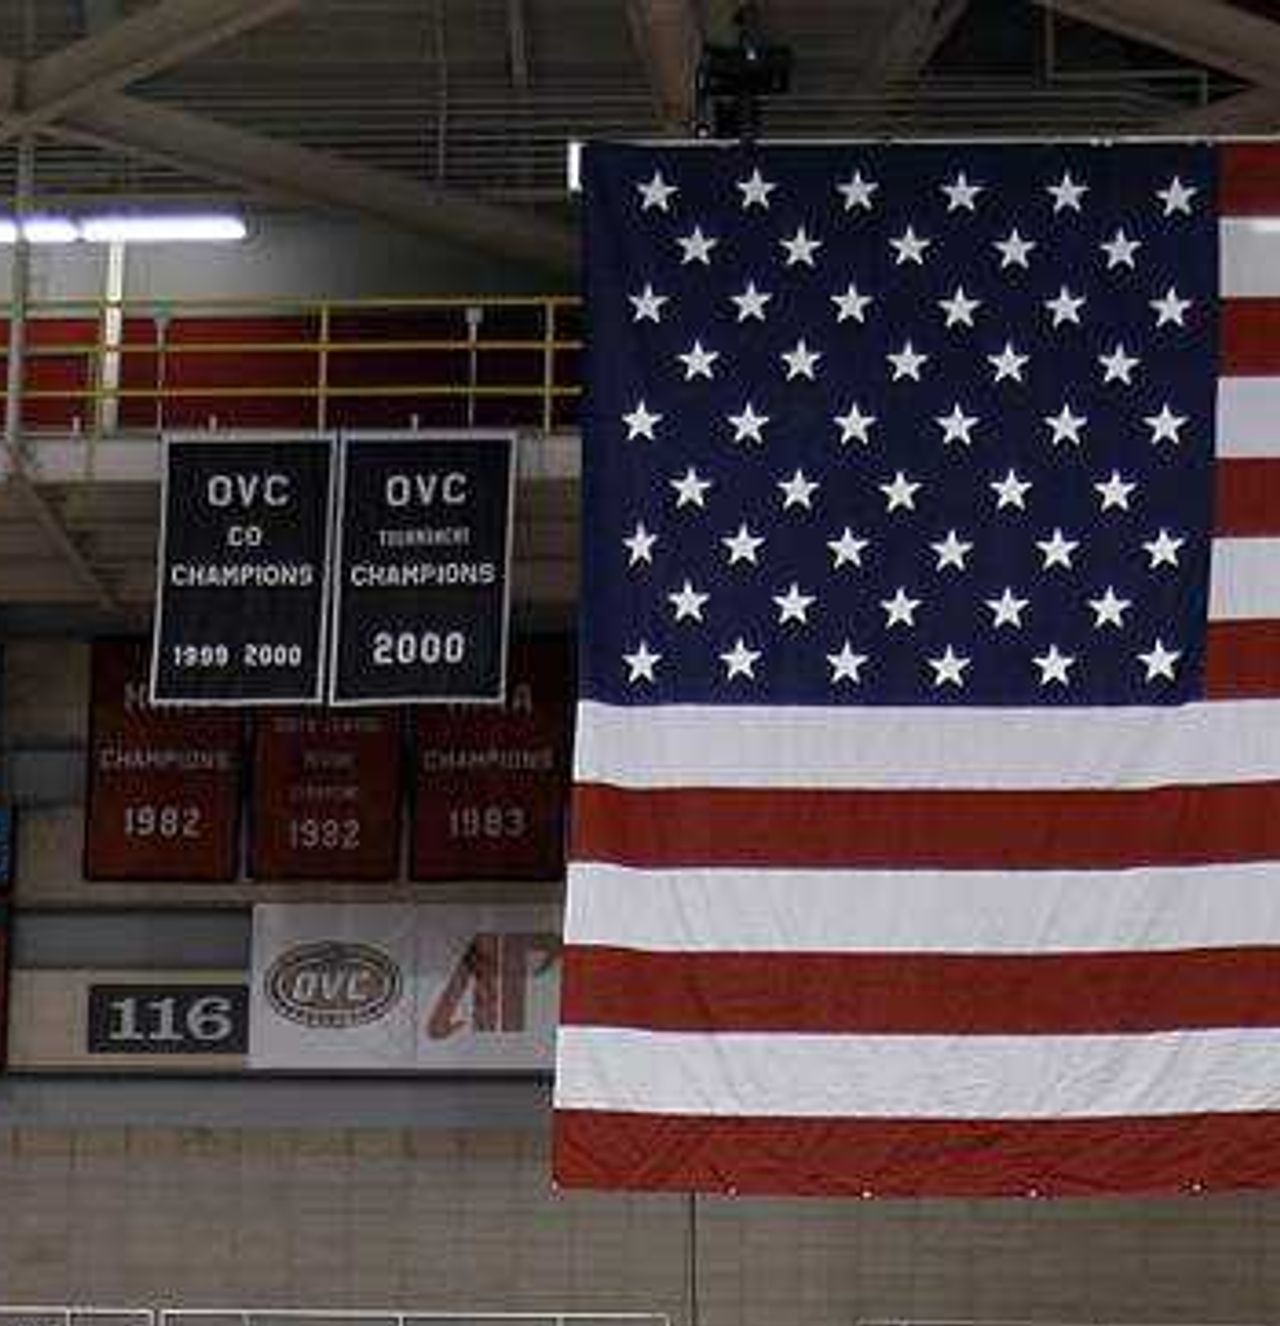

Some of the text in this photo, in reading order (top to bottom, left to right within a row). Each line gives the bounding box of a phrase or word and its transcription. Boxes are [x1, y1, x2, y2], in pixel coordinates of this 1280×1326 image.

[207, 474, 290, 507] OVC
[386, 473, 467, 507] OVC
[227, 526, 263, 547] CO
[379, 527, 470, 547] TOURNAMENT
[171, 562, 314, 587] CHAMPIONS
[350, 562, 496, 587] CHAMPIONS
[244, 644, 302, 667] 2000
[372, 632, 465, 665] 2000
[423, 747, 554, 770] CHAMPIONS
[124, 807, 201, 838] 1982
[449, 806, 527, 838] 1983
[108, 997, 232, 1041] 116
